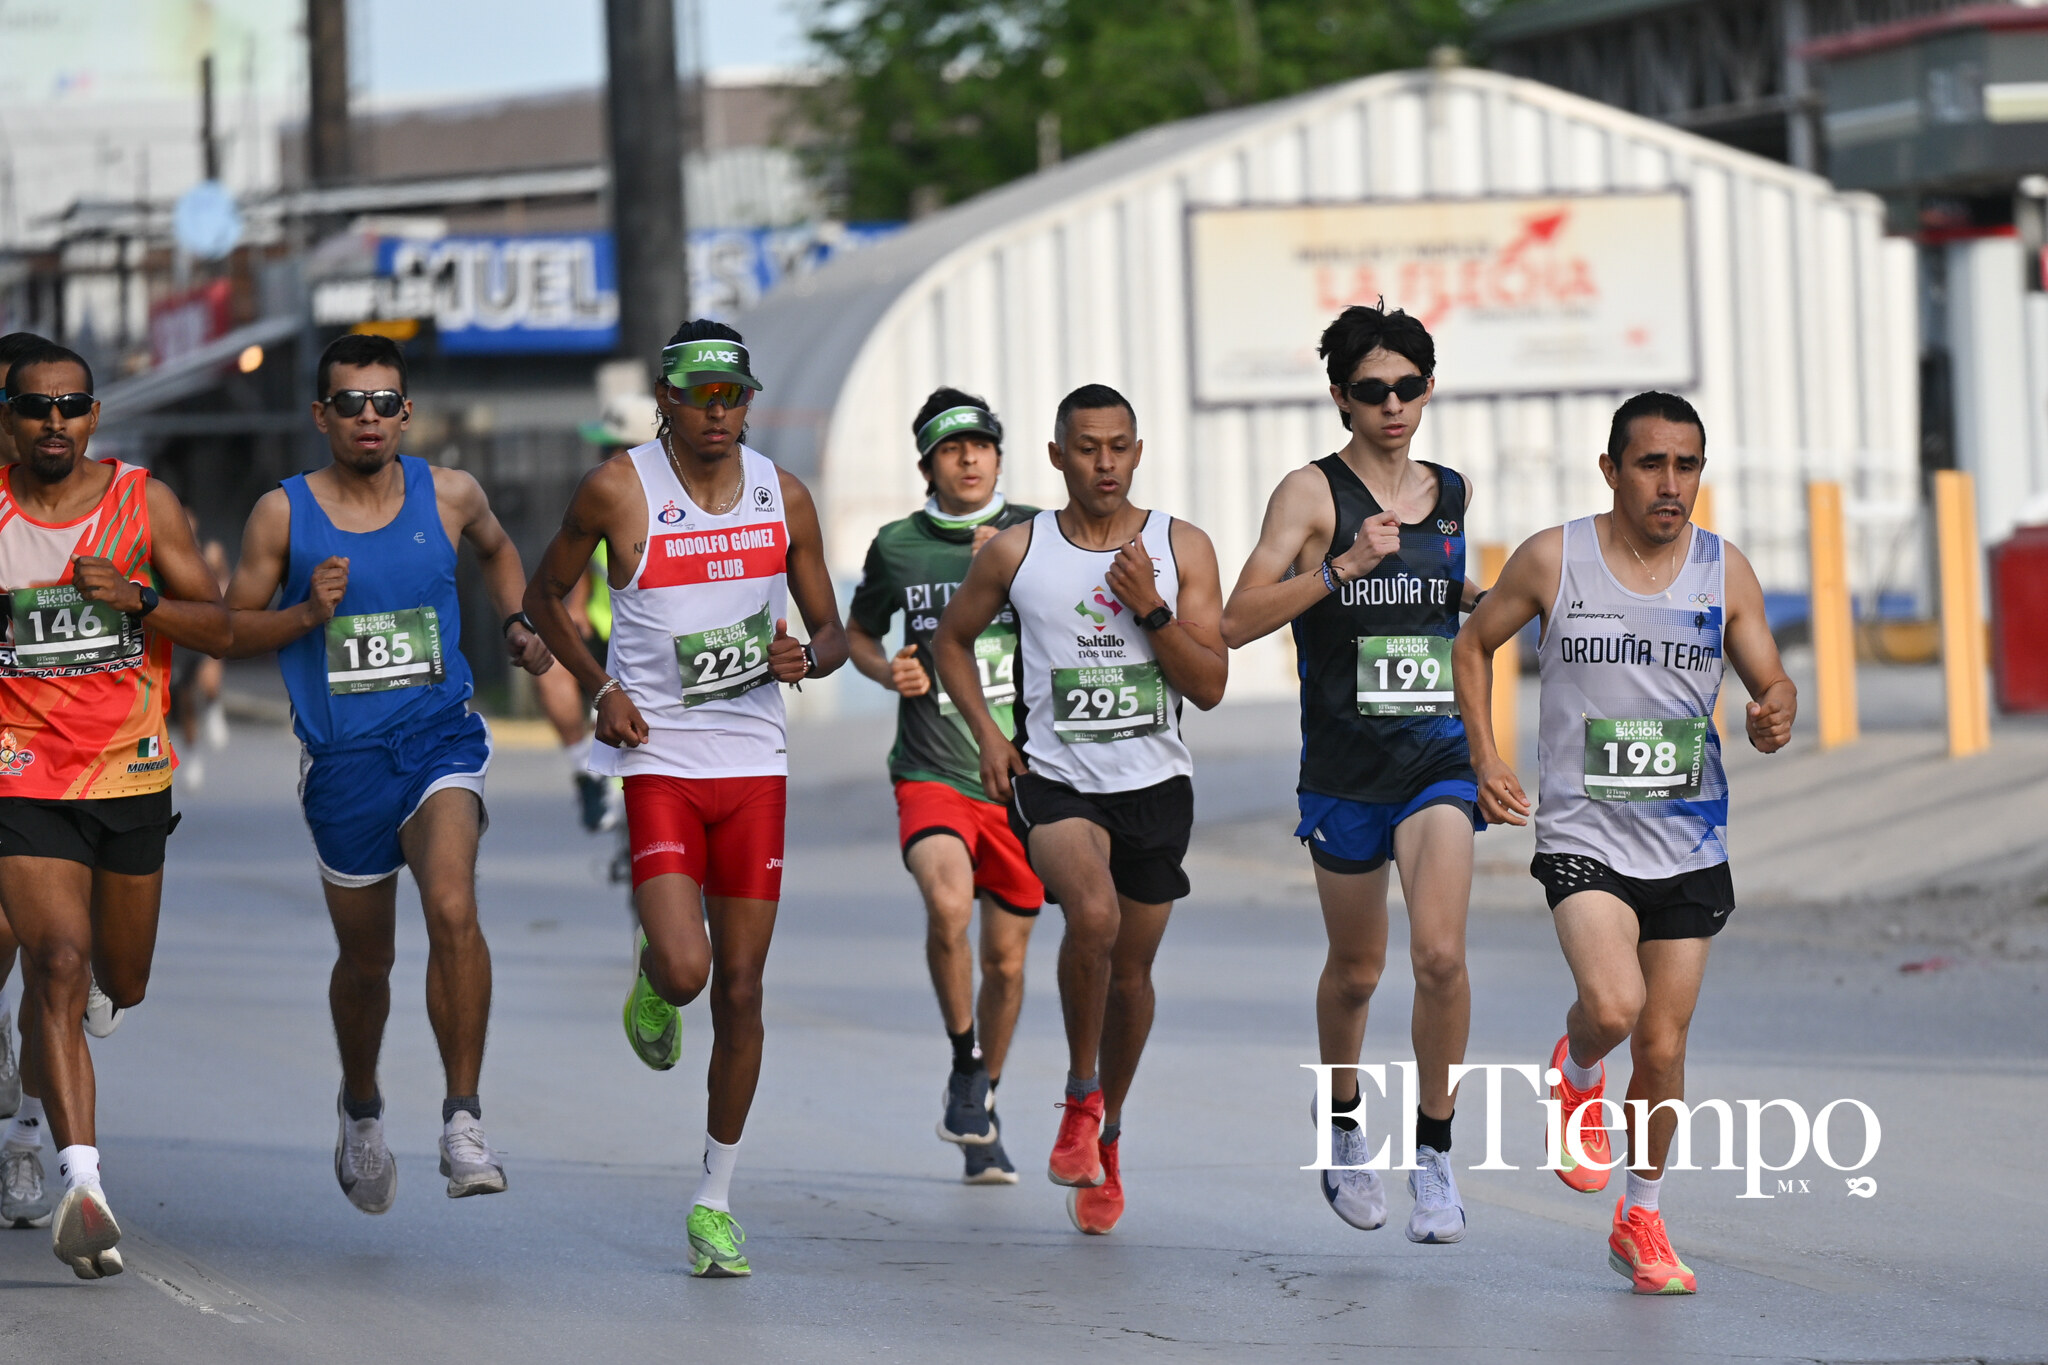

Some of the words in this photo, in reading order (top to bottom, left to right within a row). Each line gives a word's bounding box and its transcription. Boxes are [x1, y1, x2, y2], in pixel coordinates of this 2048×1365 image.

[665, 534, 729, 558] RODOLFO
[730, 528, 775, 551] GÓMEZ
[707, 558, 744, 580] CLUB
[36, 587, 78, 596] CARRER
[904, 583, 932, 611] El
[1341, 573, 1422, 606] ORDUÑA
[28, 605, 102, 642] 146
[120, 611, 130, 646] MEDA
[353, 614, 395, 624] CARRERA
[703, 622, 746, 638] CARRERA
[911, 614, 939, 631] de
[1566, 612, 1625, 620] EFRAIN
[343, 632, 413, 669] 185
[430, 623, 442, 675] MEDALLA
[1077, 635, 1125, 648] Saltillo
[1101, 649, 1127, 658] une.
[1561, 633, 1652, 666] ORDUÑA
[1661, 641, 1715, 673] TEAM
[693, 636, 762, 684] 225
[976, 654, 1015, 687] 14
[1374, 658, 1440, 690] 199
[1067, 686, 1139, 719] 295
[1156, 676, 1164, 725] MEDALLA
[1603, 741, 1677, 775] 198
[1690, 734, 1702, 787] MEDALLA
